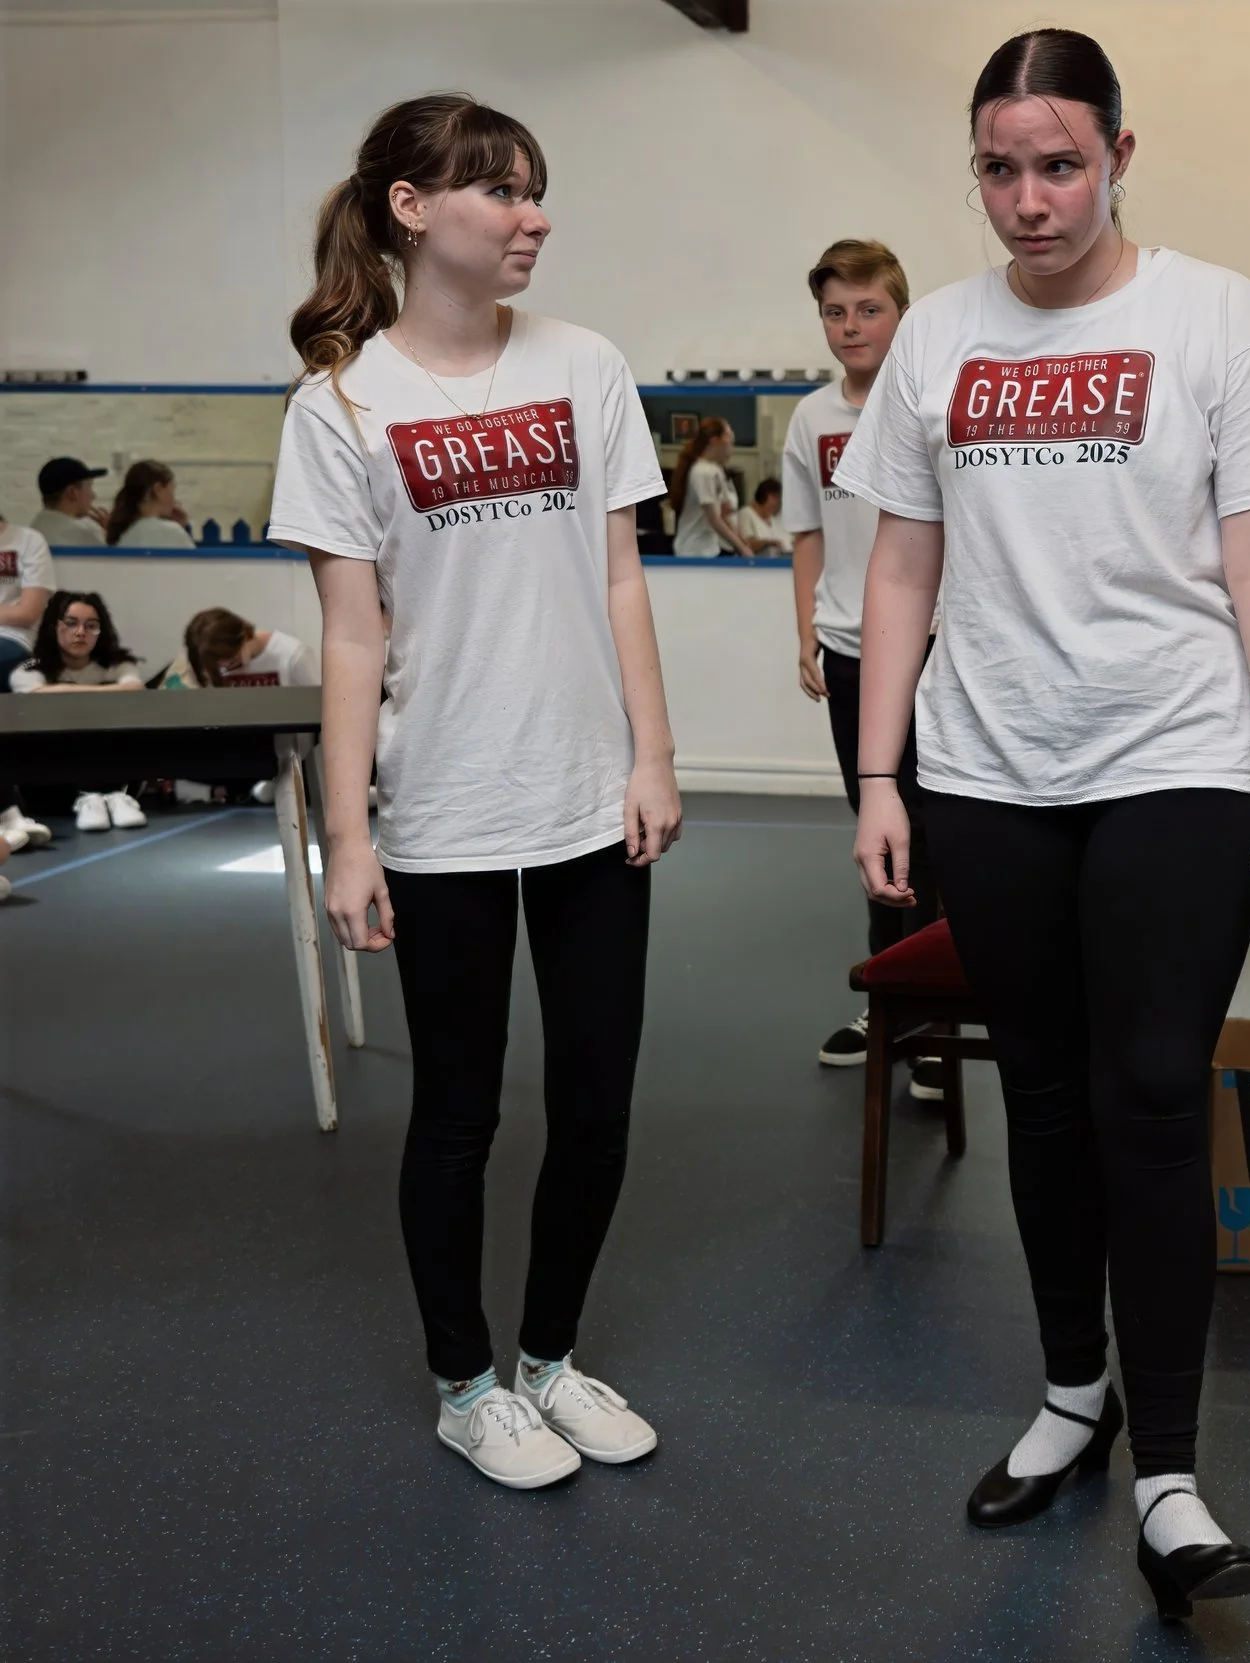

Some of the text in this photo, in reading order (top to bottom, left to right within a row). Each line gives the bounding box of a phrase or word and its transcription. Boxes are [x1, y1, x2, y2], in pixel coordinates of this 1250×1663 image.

[1000, 358, 1108, 379] WE GO TOGETHER
[966, 372, 1137, 420] GREASE
[432, 408, 540, 436] WE GO TOGETHER
[965, 420, 1131, 438] 19 THE MUSICAL 59
[413, 421, 574, 482] GREASE
[953, 442, 1132, 470] DOSYTCo 2025
[431, 486, 445, 501] 19
[452, 479, 480, 495] THE
[489, 469, 557, 491] MUSICAL
[425, 490, 576, 532] DOSYTCo 202
